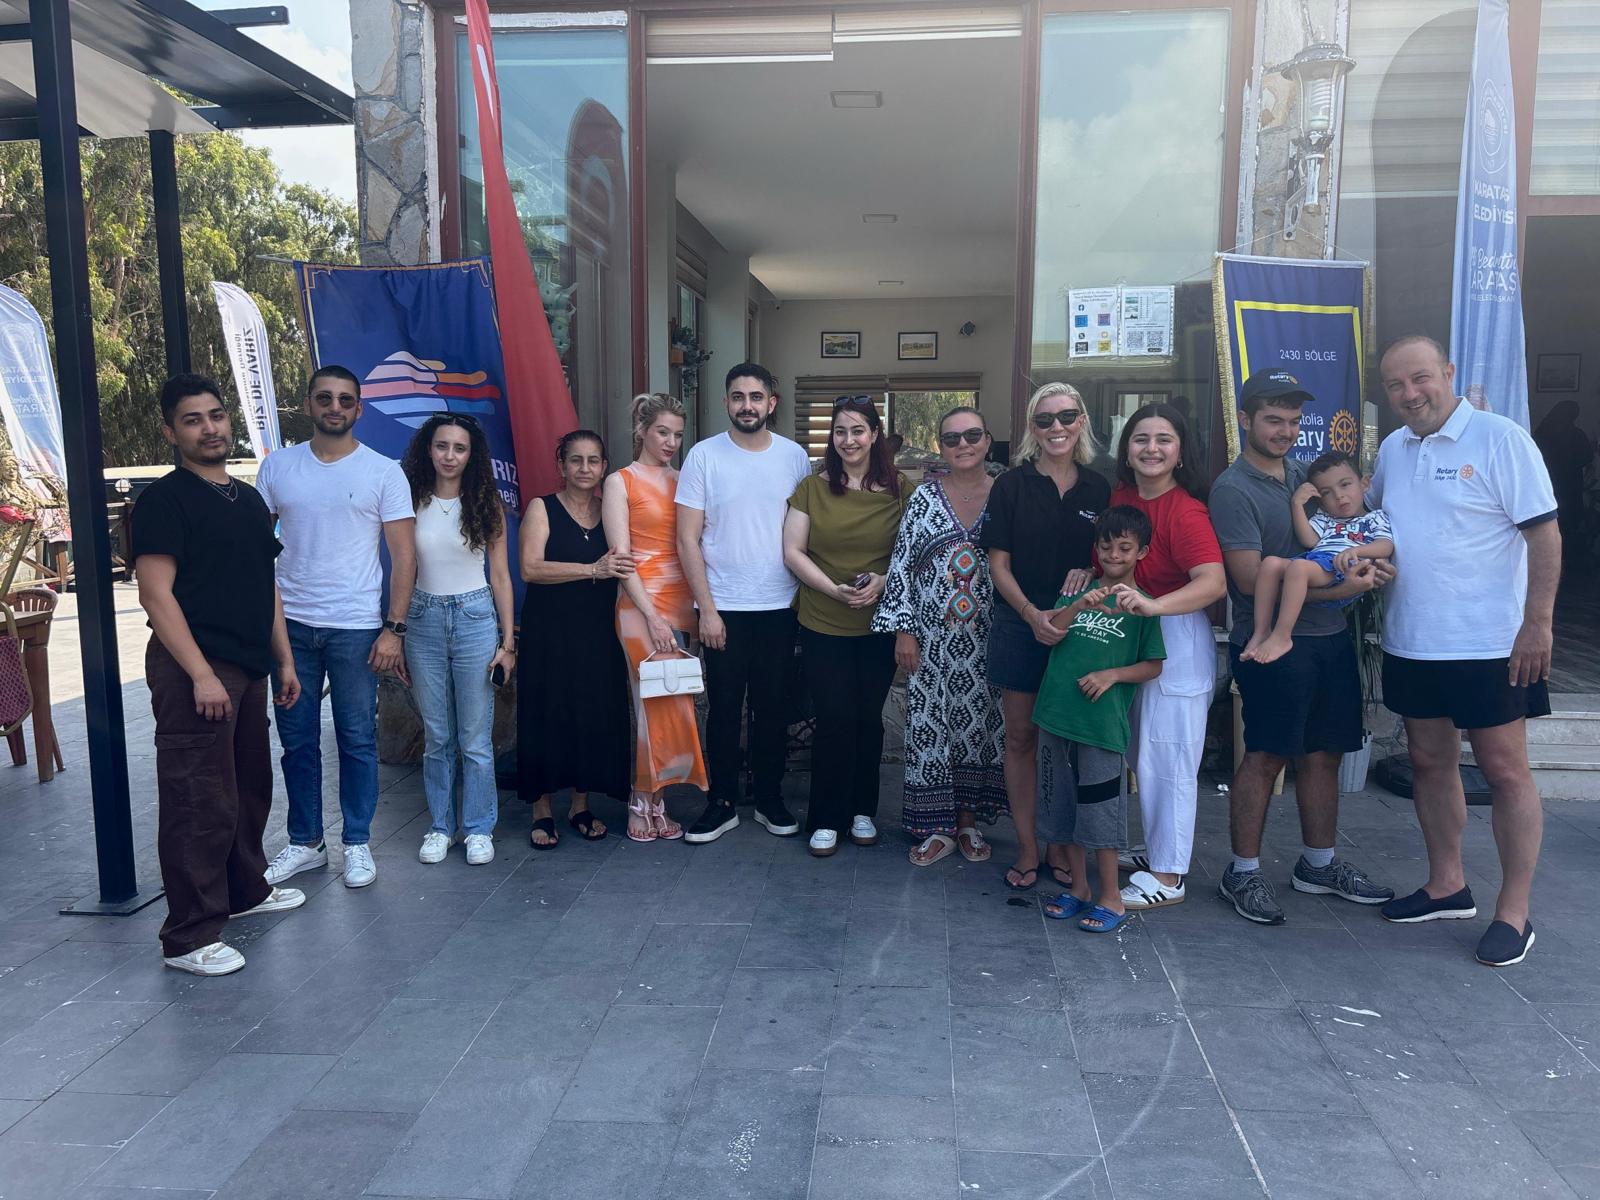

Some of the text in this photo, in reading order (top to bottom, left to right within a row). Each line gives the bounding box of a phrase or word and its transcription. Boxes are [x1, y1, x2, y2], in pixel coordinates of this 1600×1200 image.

[1474, 204, 1517, 225] ELEDİYESİ
[1304, 349, 1337, 361] BÖLGE
[1299, 412, 1324, 426] tolia
[1293, 430, 1325, 452] ary
[490, 458, 519, 487] RIZ
[1435, 467, 1459, 476] Rotary
[1092, 629, 1108, 638] DAY
